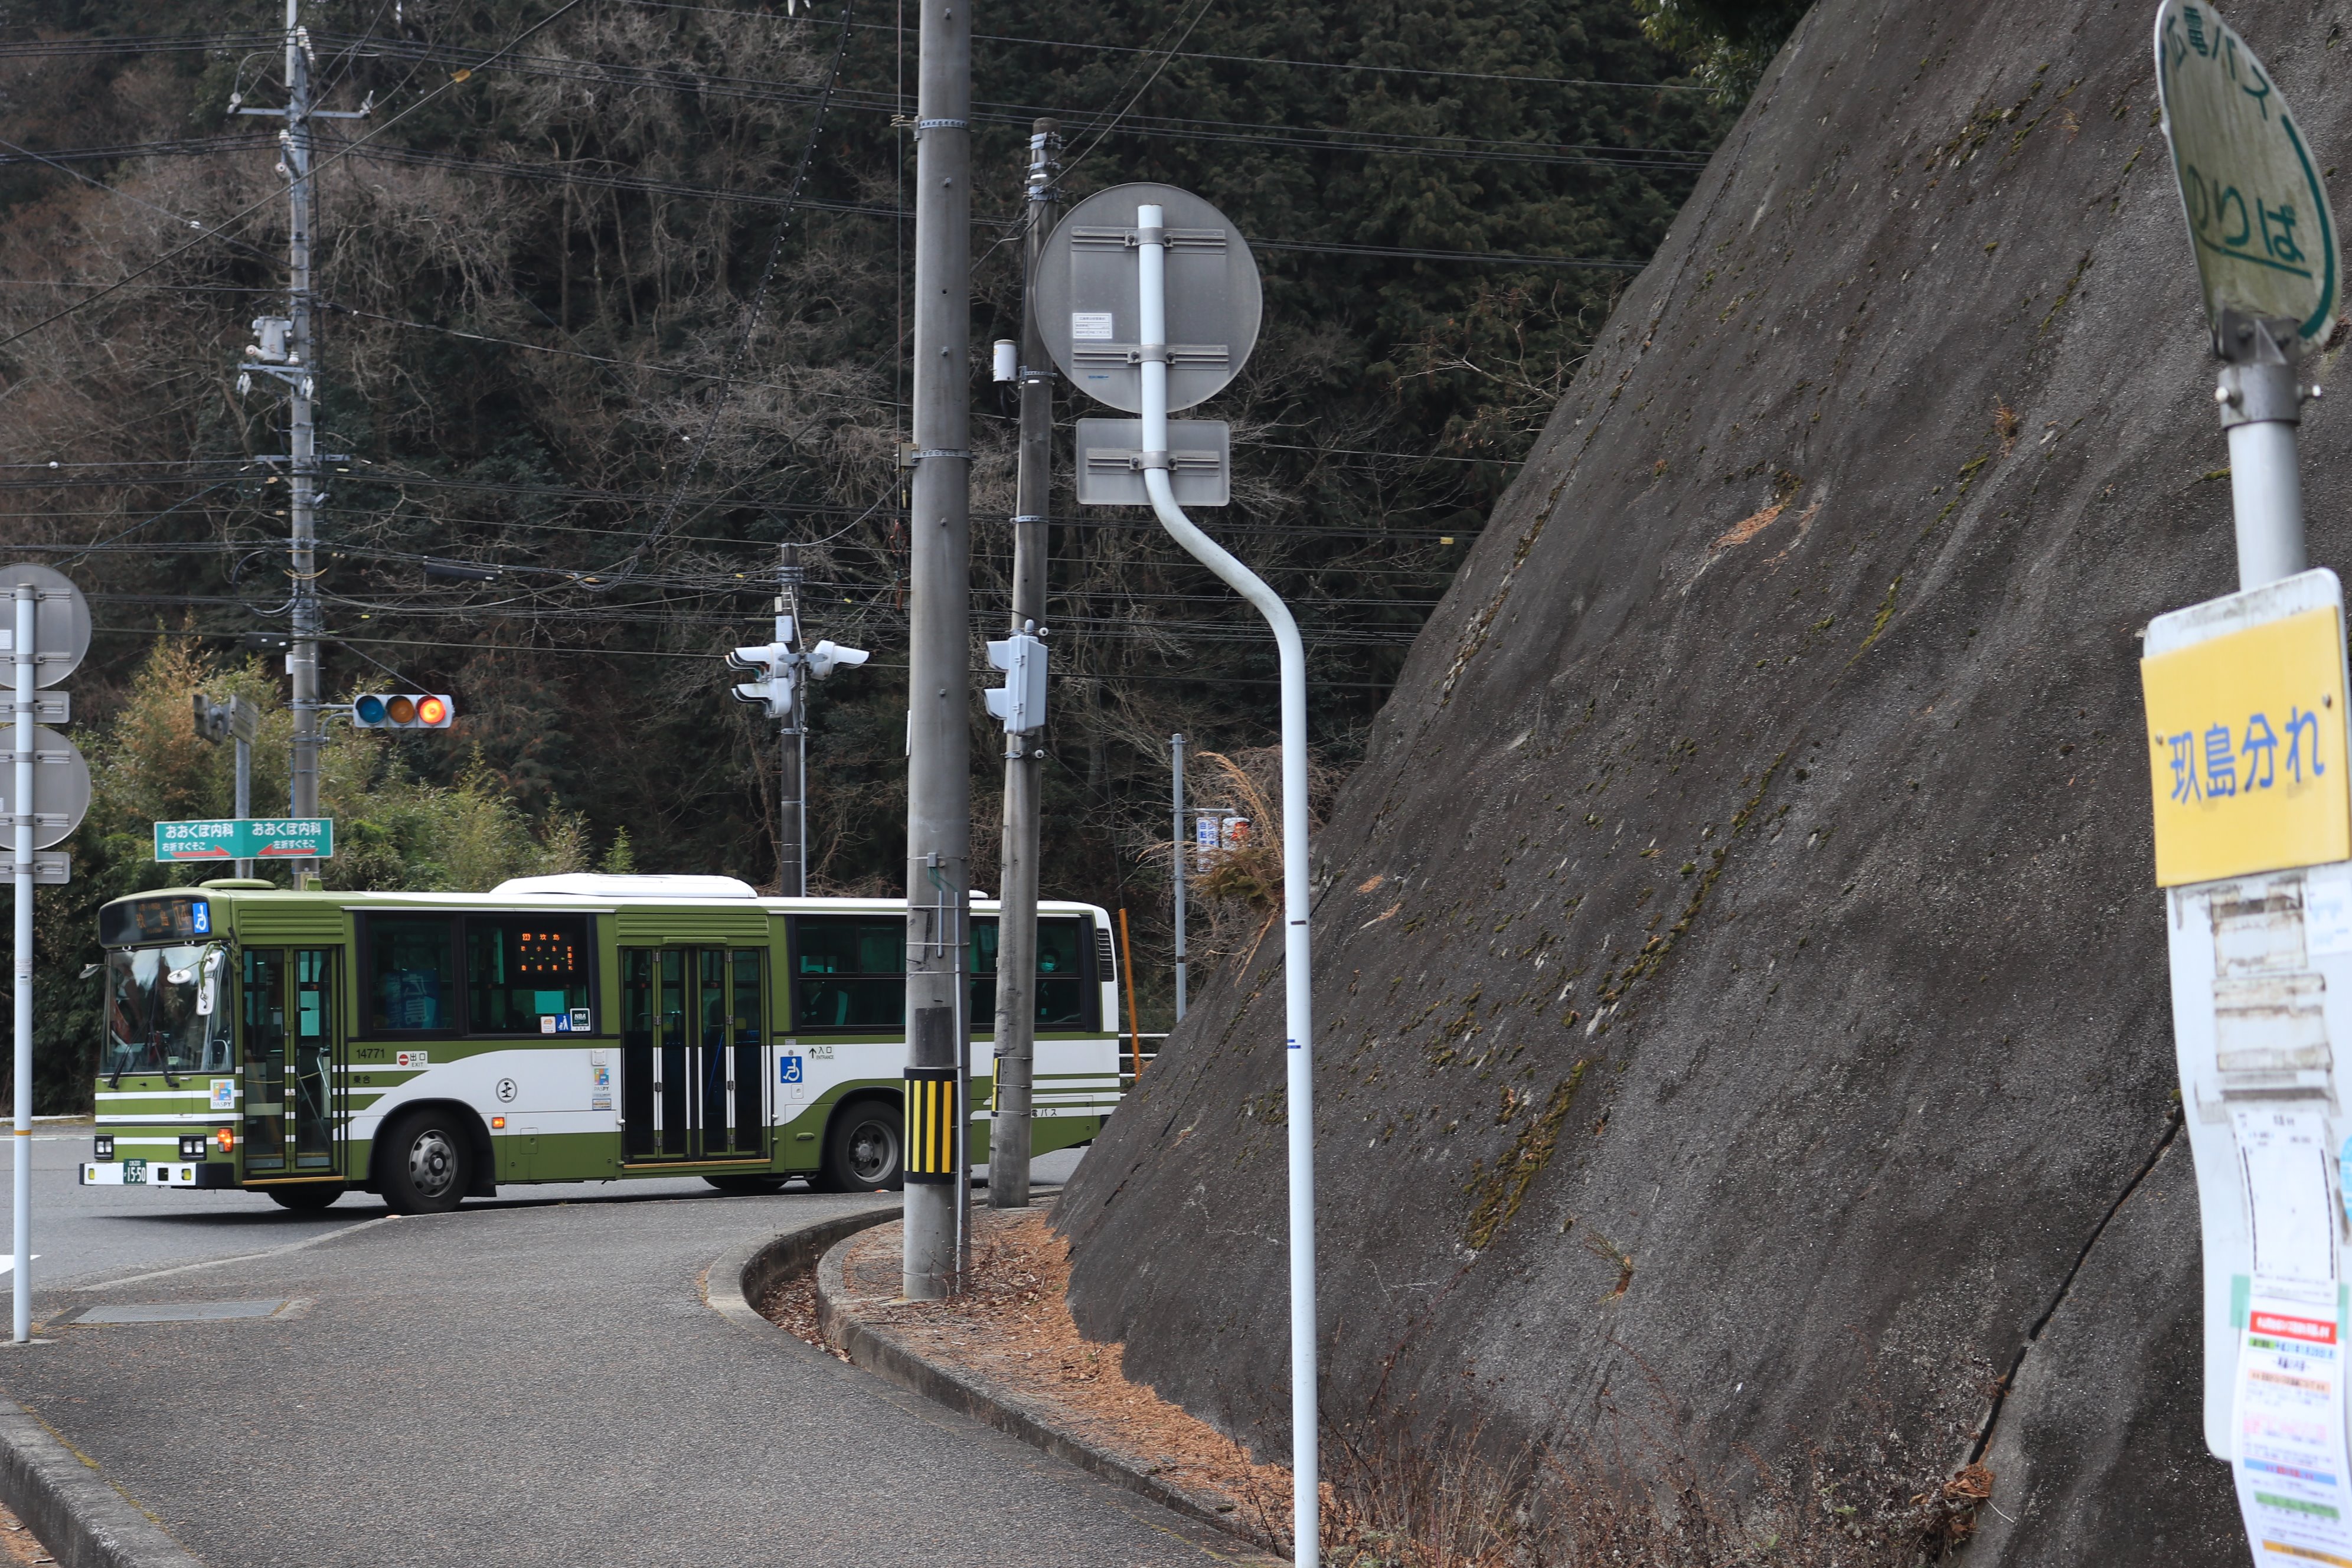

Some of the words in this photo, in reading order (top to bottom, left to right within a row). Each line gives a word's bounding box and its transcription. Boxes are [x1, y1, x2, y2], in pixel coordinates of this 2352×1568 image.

[2187, 164, 2305, 262] のりば
[2168, 705, 2325, 805] 玖島分れ
[166, 823, 234, 839] おおくぼ内科
[252, 822, 322, 837] おおくぼ内科
[162, 842, 206, 852] 右折すぐそこ
[273, 839, 316, 850] 左折すぐそこ
[356, 1048, 385, 1059] 14771
[410, 1053, 426, 1061] 出口
[354, 1075, 371, 1084] 乗合
[1031, 1109, 1057, 1117] 電バス
[127, 1167, 146, 1182] 15-50
